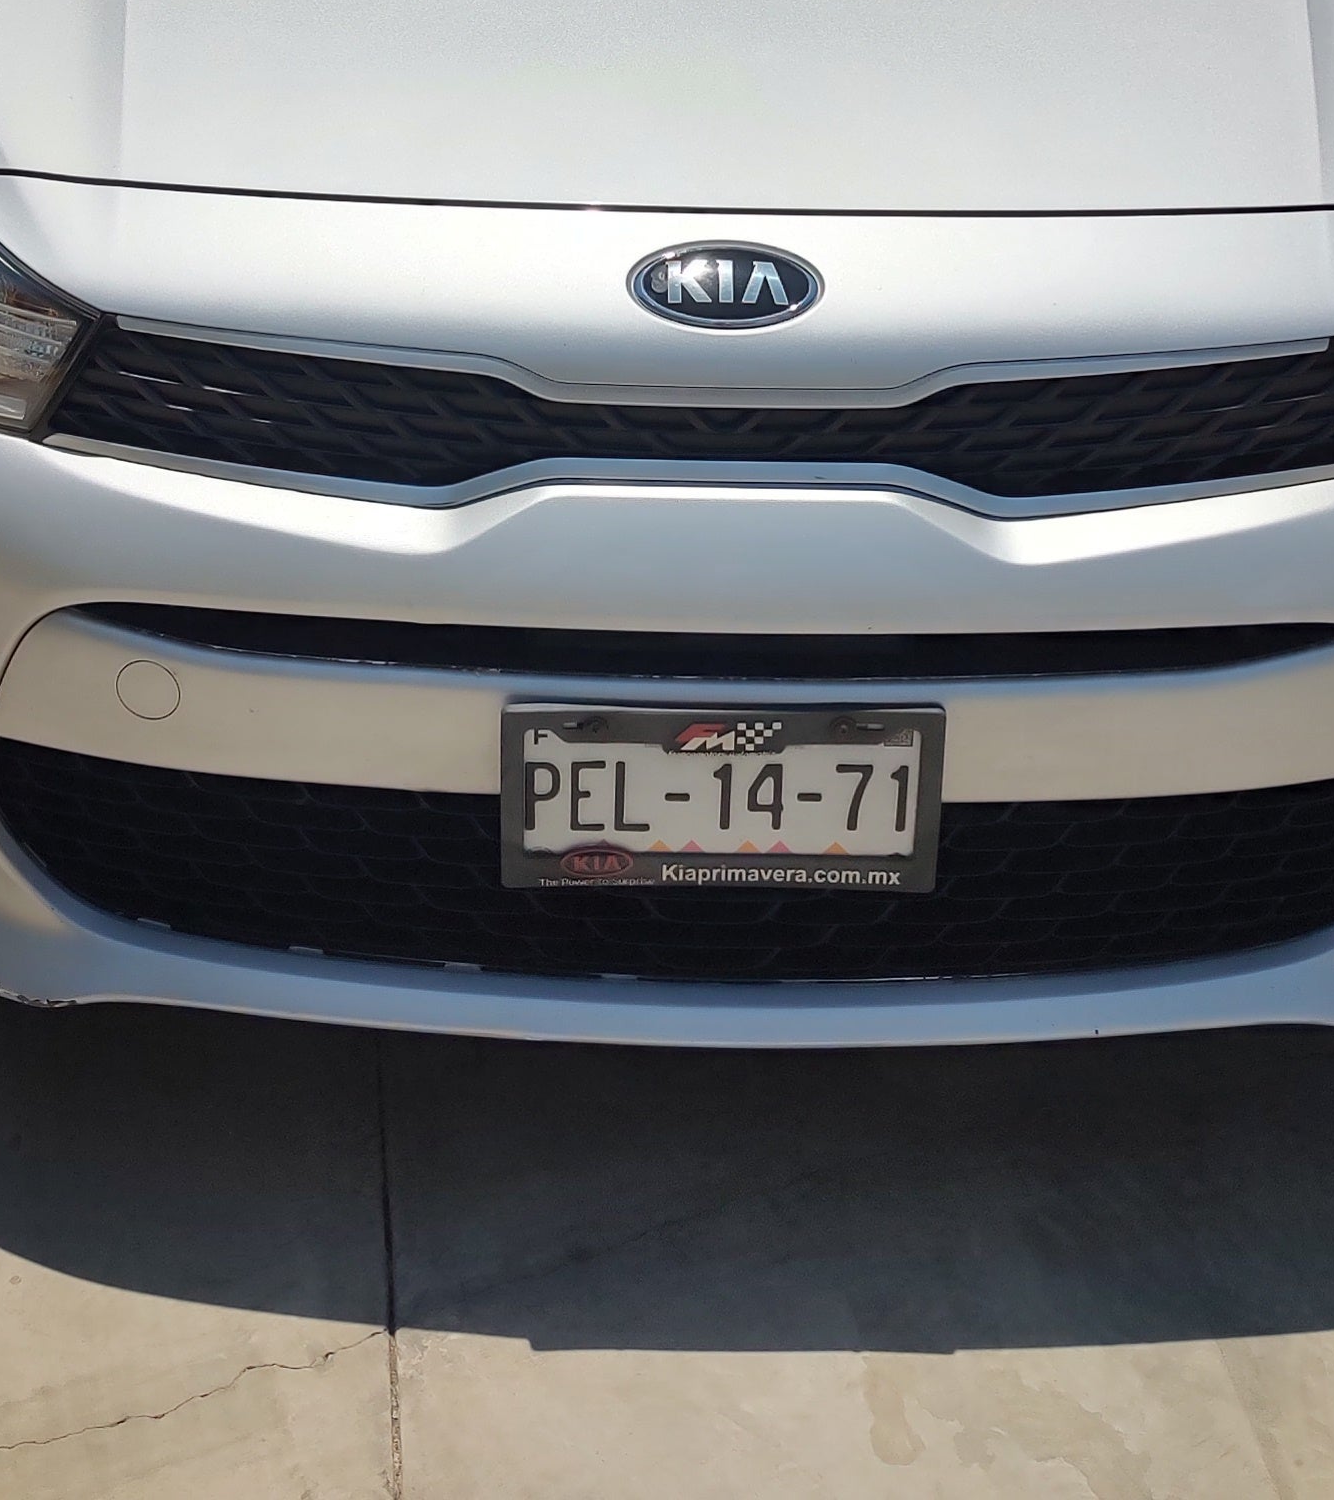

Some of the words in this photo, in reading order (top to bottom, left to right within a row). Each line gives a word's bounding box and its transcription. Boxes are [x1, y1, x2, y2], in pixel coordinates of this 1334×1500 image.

[665, 259, 789, 306] KIA
[524, 760, 909, 833] PEL-14-71
[573, 855, 621, 871] KIA
[538, 878, 559, 887] The
[661, 864, 901, 887] Kiaprimavera.com.mx
